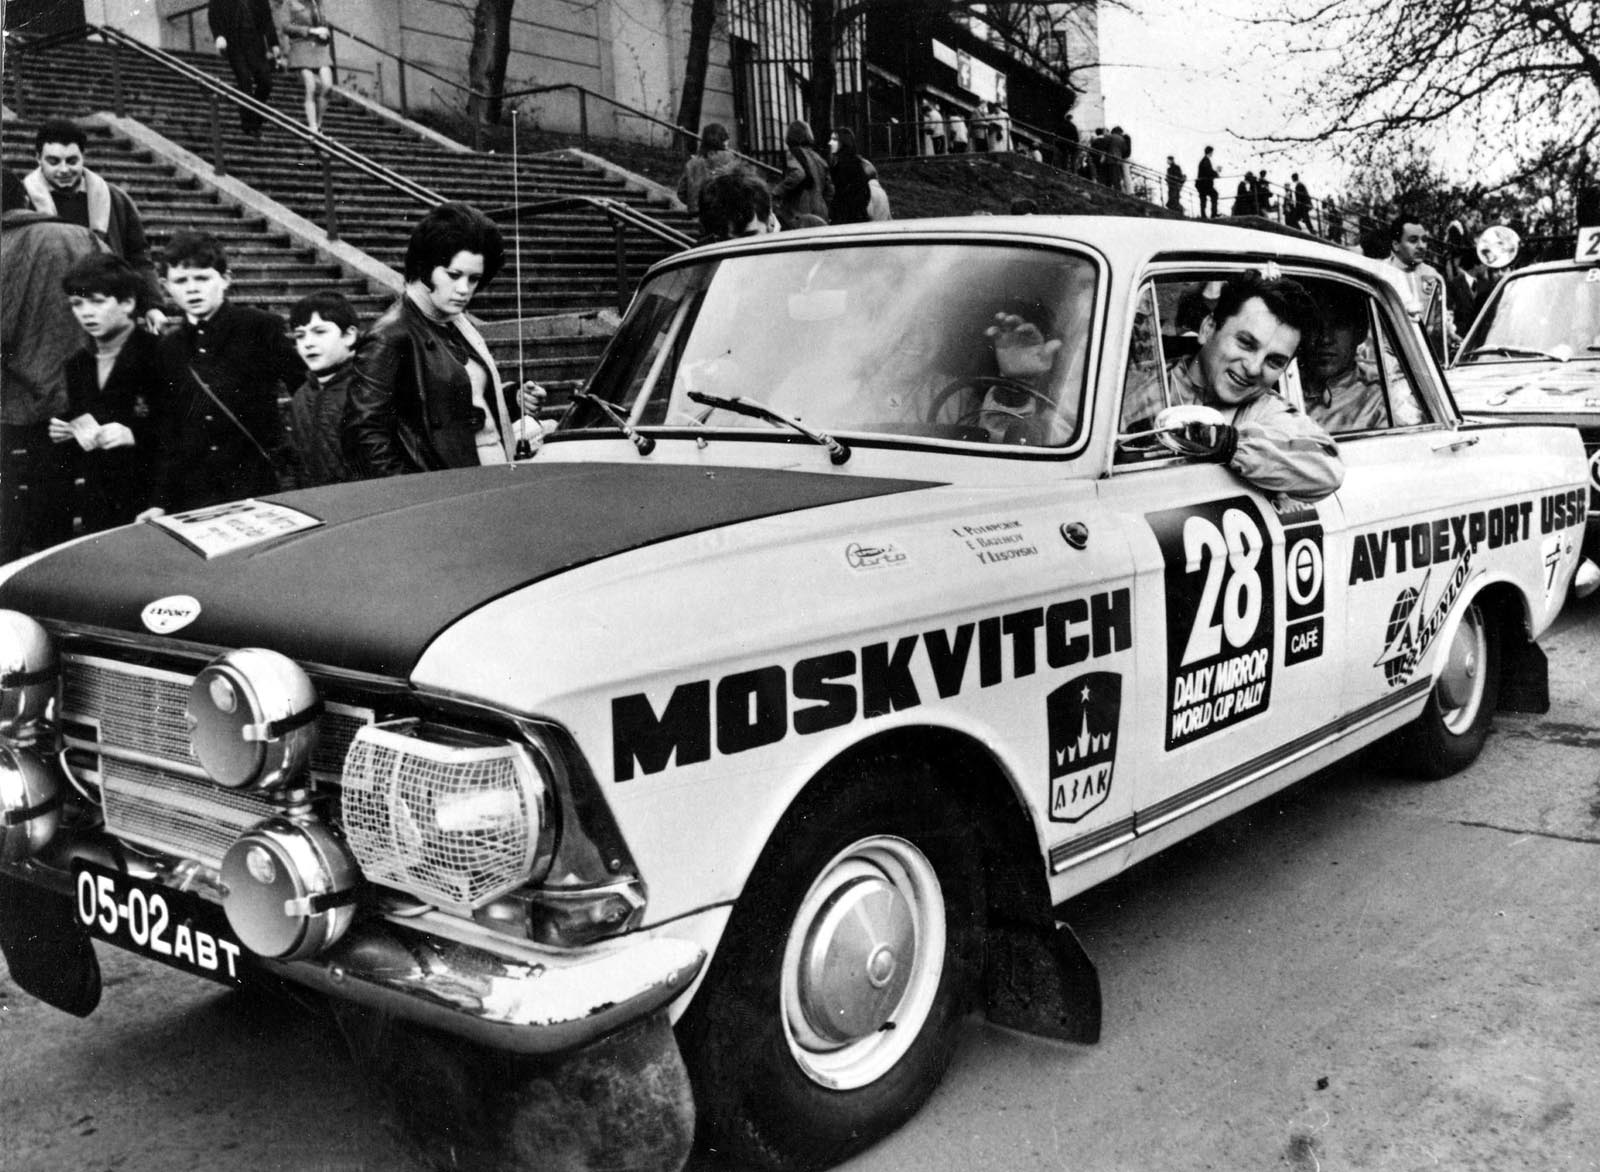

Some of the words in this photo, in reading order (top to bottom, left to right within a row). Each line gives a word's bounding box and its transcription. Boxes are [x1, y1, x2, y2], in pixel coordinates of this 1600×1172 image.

[1349, 501, 1533, 586] AVTOEXPORT
[1541, 488, 1586, 534] USSR
[1180, 508, 1264, 667] 28
[1420, 550, 1471, 655] DUNLOP
[612, 587, 1132, 783] MOSKVITCH
[1173, 665, 1215, 711] DAILY
[1213, 648, 1269, 696] MIRROR
[1291, 626, 1318, 653] CAFÉ
[1172, 702, 1212, 740] WORLD
[1213, 693, 1235, 722] CUP
[1234, 680, 1266, 714] RALLY
